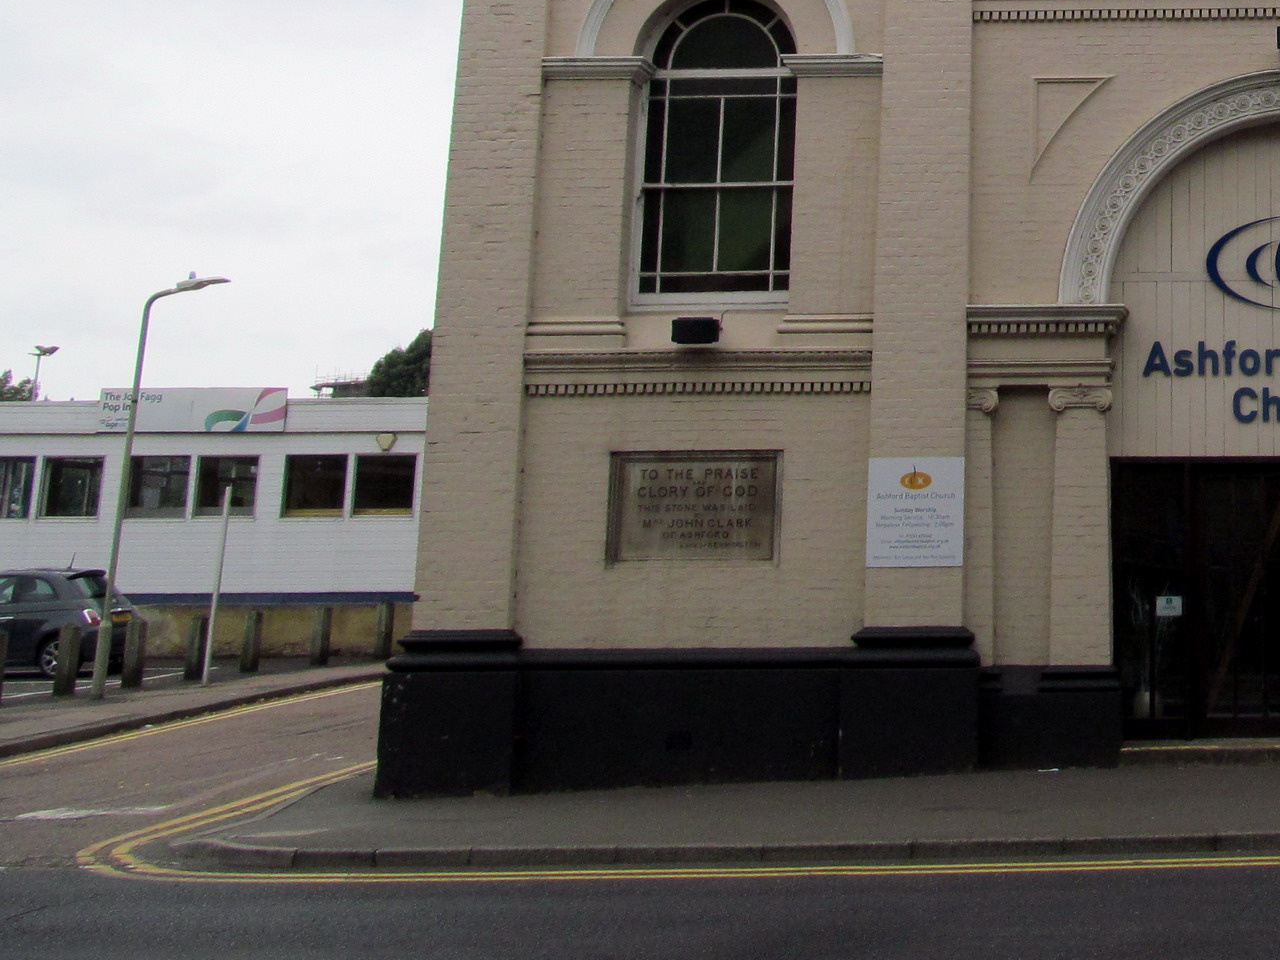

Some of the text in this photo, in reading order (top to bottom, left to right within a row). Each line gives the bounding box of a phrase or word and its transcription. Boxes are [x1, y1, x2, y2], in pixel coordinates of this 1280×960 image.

[104, 392, 120, 401] The
[140, 392, 162, 403] Fagg
[103, 403, 120, 413] Pop
[639, 467, 760, 480] TO THE PRAISE
[695, 485, 716, 498] OF
[877, 491, 956, 501] Ashford Baptist Church
[667, 518, 704, 529] JOHN
[707, 517, 753, 529] CLARK
[679, 530, 730, 539] ASHFORD
